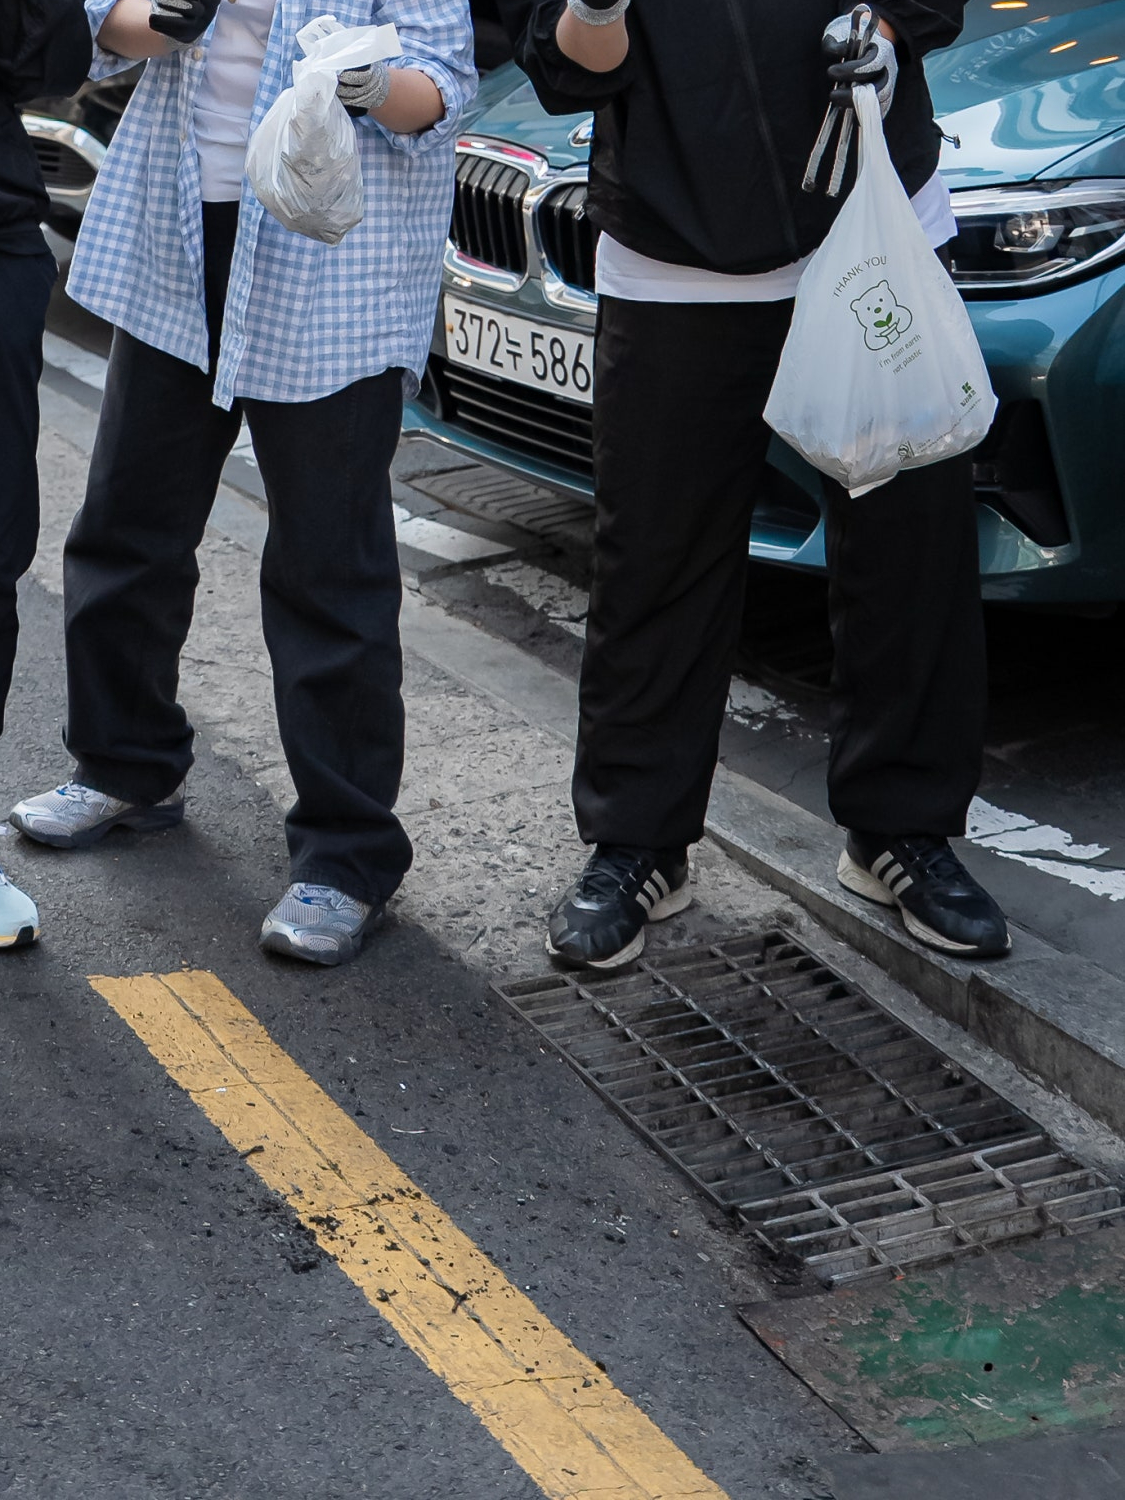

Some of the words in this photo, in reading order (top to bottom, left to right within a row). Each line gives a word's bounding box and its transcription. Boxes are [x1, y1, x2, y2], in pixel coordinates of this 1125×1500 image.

[833, 263, 864, 298] THANK
[863, 255, 888, 269] YOU
[453, 308, 523, 372] 372누
[530, 331, 592, 393] 586
[890, 346, 905, 360] from
[904, 333, 923, 349] earth
[892, 363, 904, 376] not
[902, 348, 923, 367] plastic
